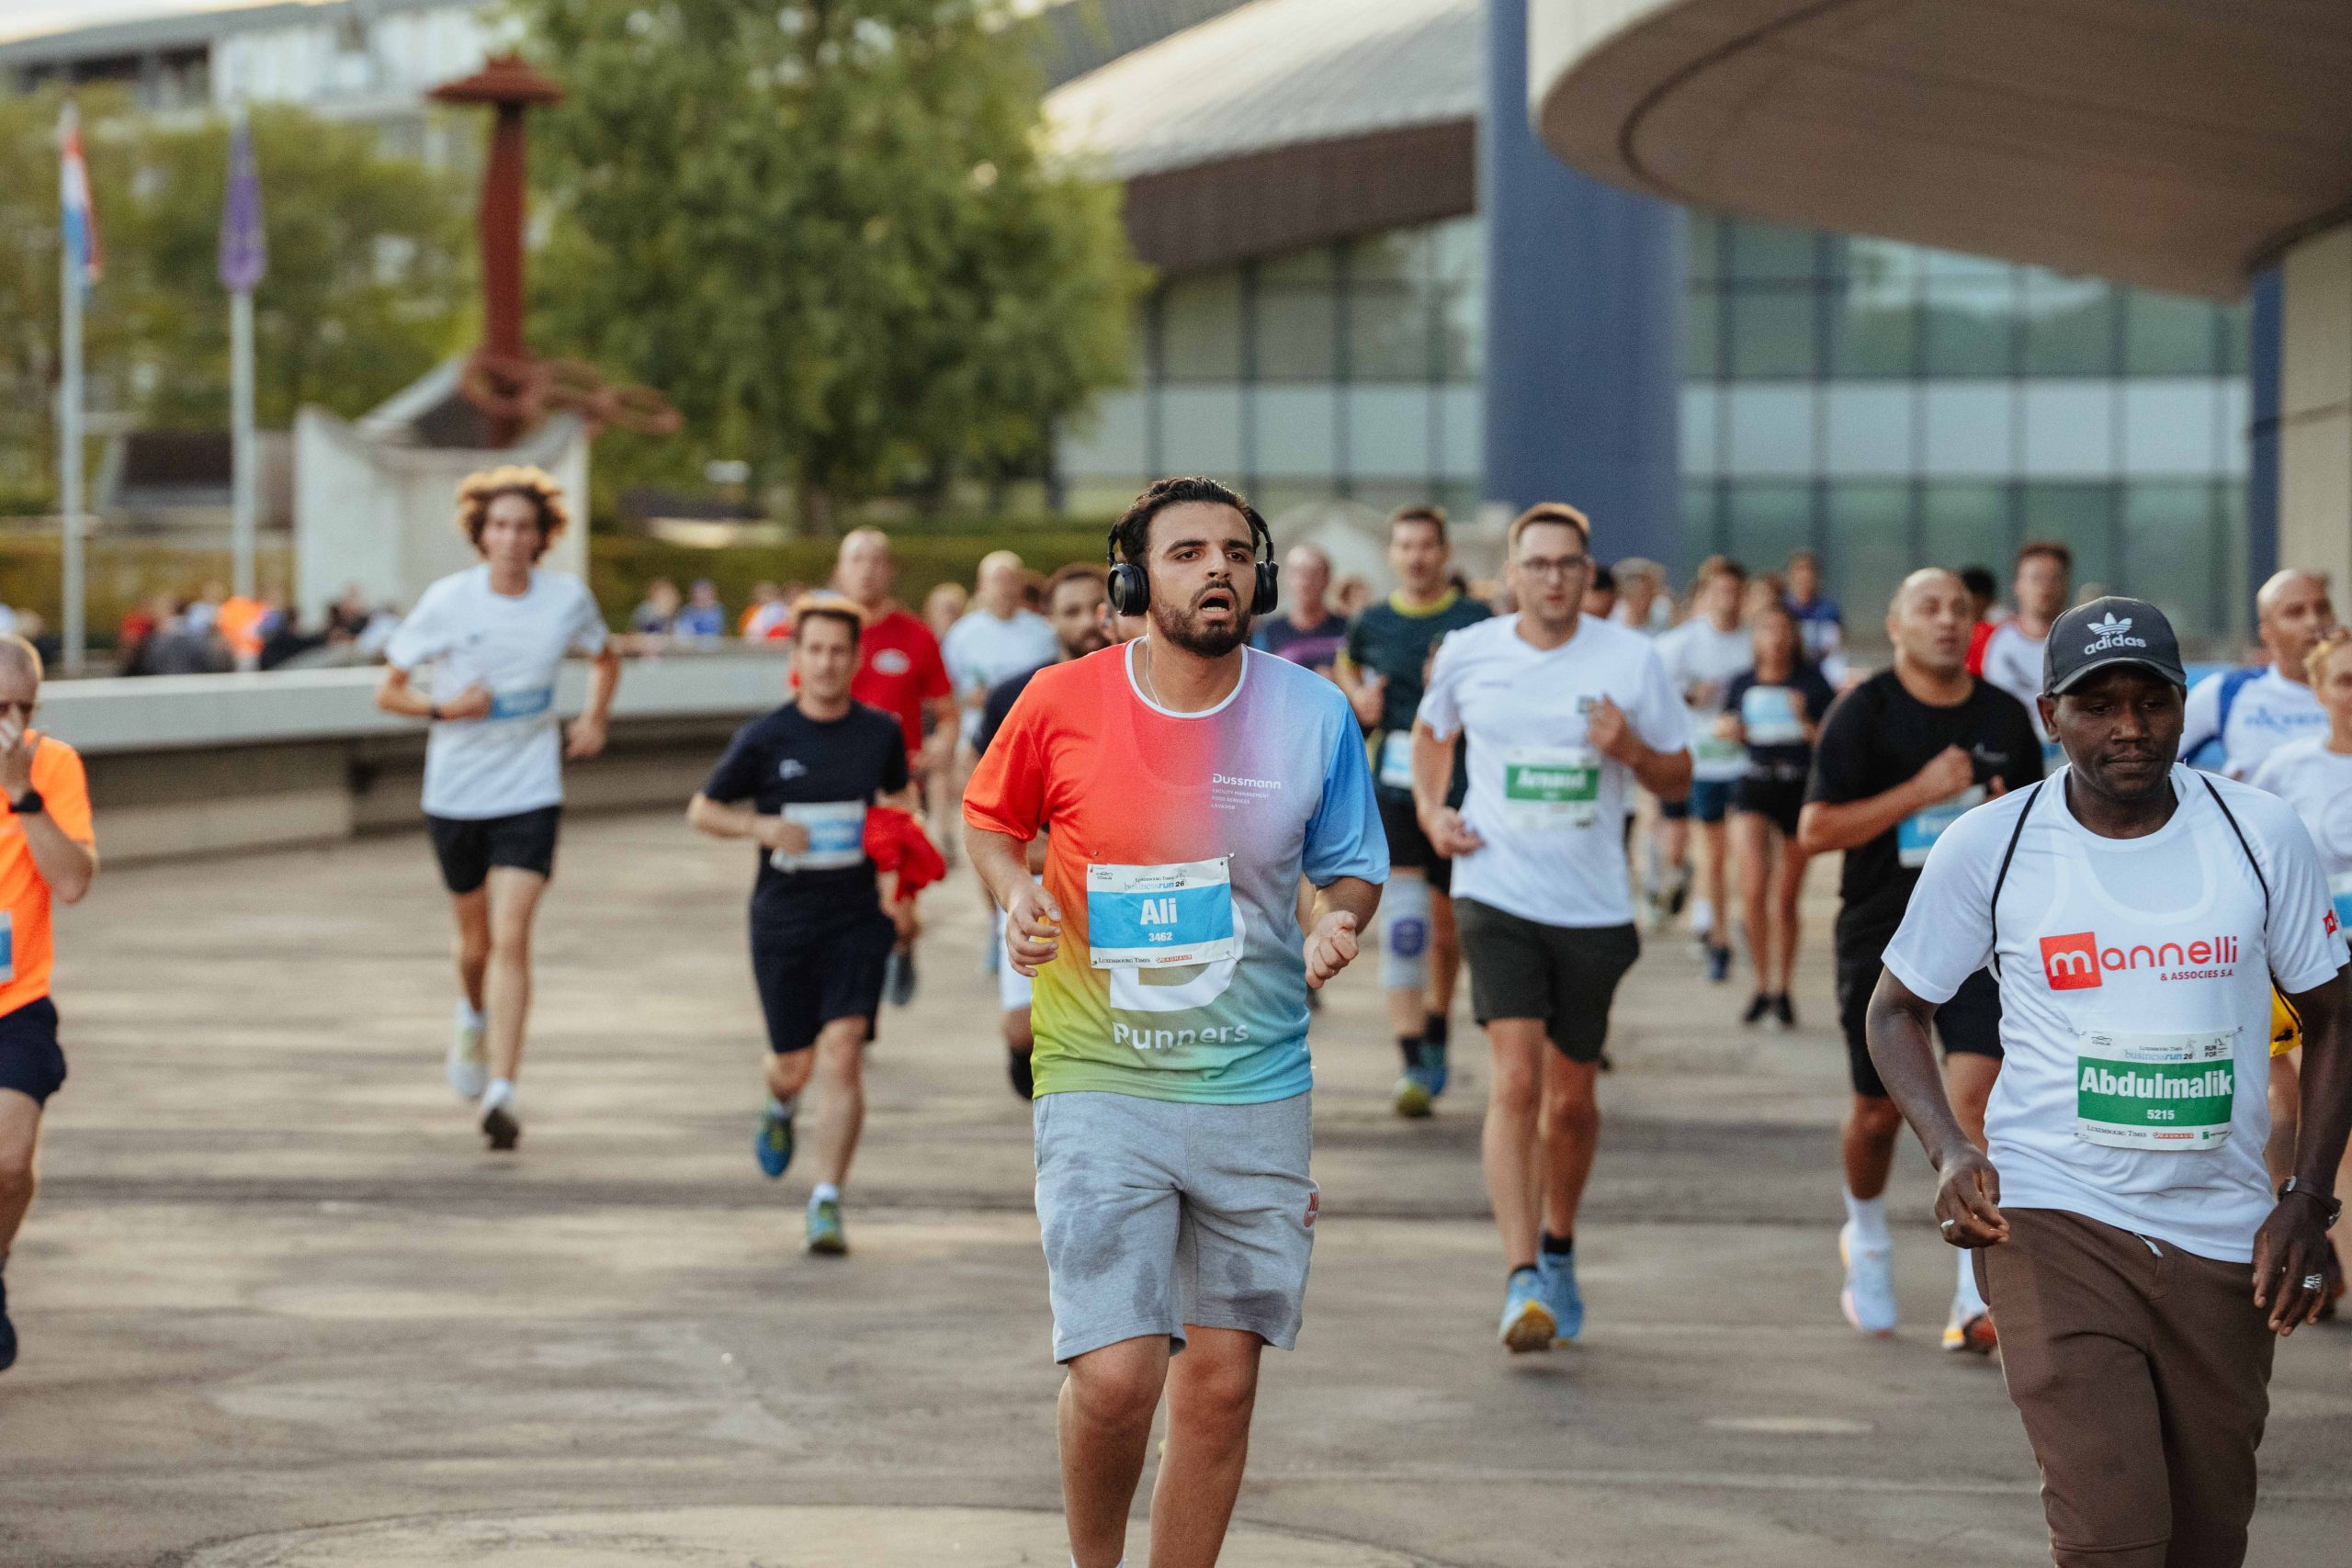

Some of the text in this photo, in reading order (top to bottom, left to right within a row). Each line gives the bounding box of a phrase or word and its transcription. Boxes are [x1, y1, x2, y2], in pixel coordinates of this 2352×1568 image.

[2084, 635, 2147, 655] adidas
[1213, 773, 1281, 789] Dussmann
[1234, 791, 1270, 799] MANAGEMENT
[1140, 897, 1178, 926] Ali
[1148, 931, 1173, 942] 3462
[2049, 935, 2238, 977] mannelli
[2161, 973, 2167, 981] &
[2171, 970, 2218, 980] ASSOCIES
[1112, 1021, 1250, 1050] Runners
[2080, 1066, 2233, 1100] Abdulmalik
[2146, 1110, 2175, 1120] 5215
